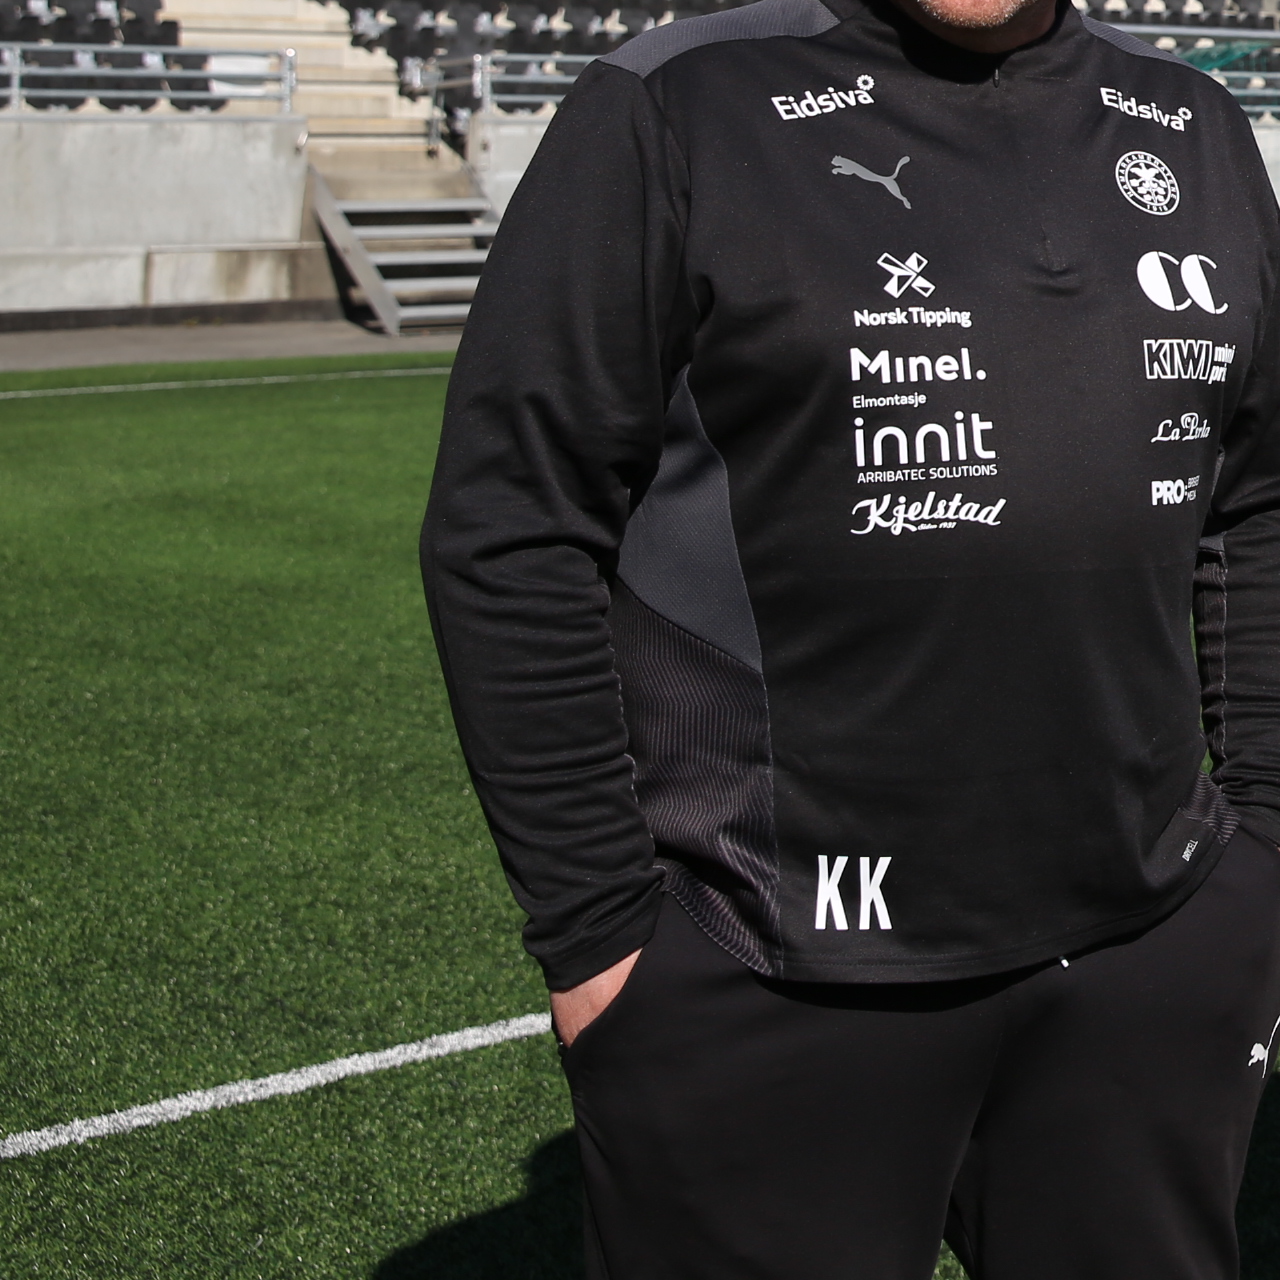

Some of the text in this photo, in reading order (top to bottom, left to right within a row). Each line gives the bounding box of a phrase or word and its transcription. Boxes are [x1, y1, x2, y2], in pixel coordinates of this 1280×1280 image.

[770, 86, 875, 120] Eidsiva
[1100, 86, 1186, 132] Eidsiva
[1136, 250, 1229, 315] CC
[853, 306, 973, 328] Norsk Tipping
[1143, 338, 1213, 380] KIWI
[852, 392, 927, 408] Elmontasje
[853, 410, 997, 467] innit
[1150, 419, 1181, 443] La
[857, 463, 998, 484] ARRIBATEC SOLUTIONS
[850, 491, 1007, 536] Kjelstad
[814, 854, 893, 931] KK
